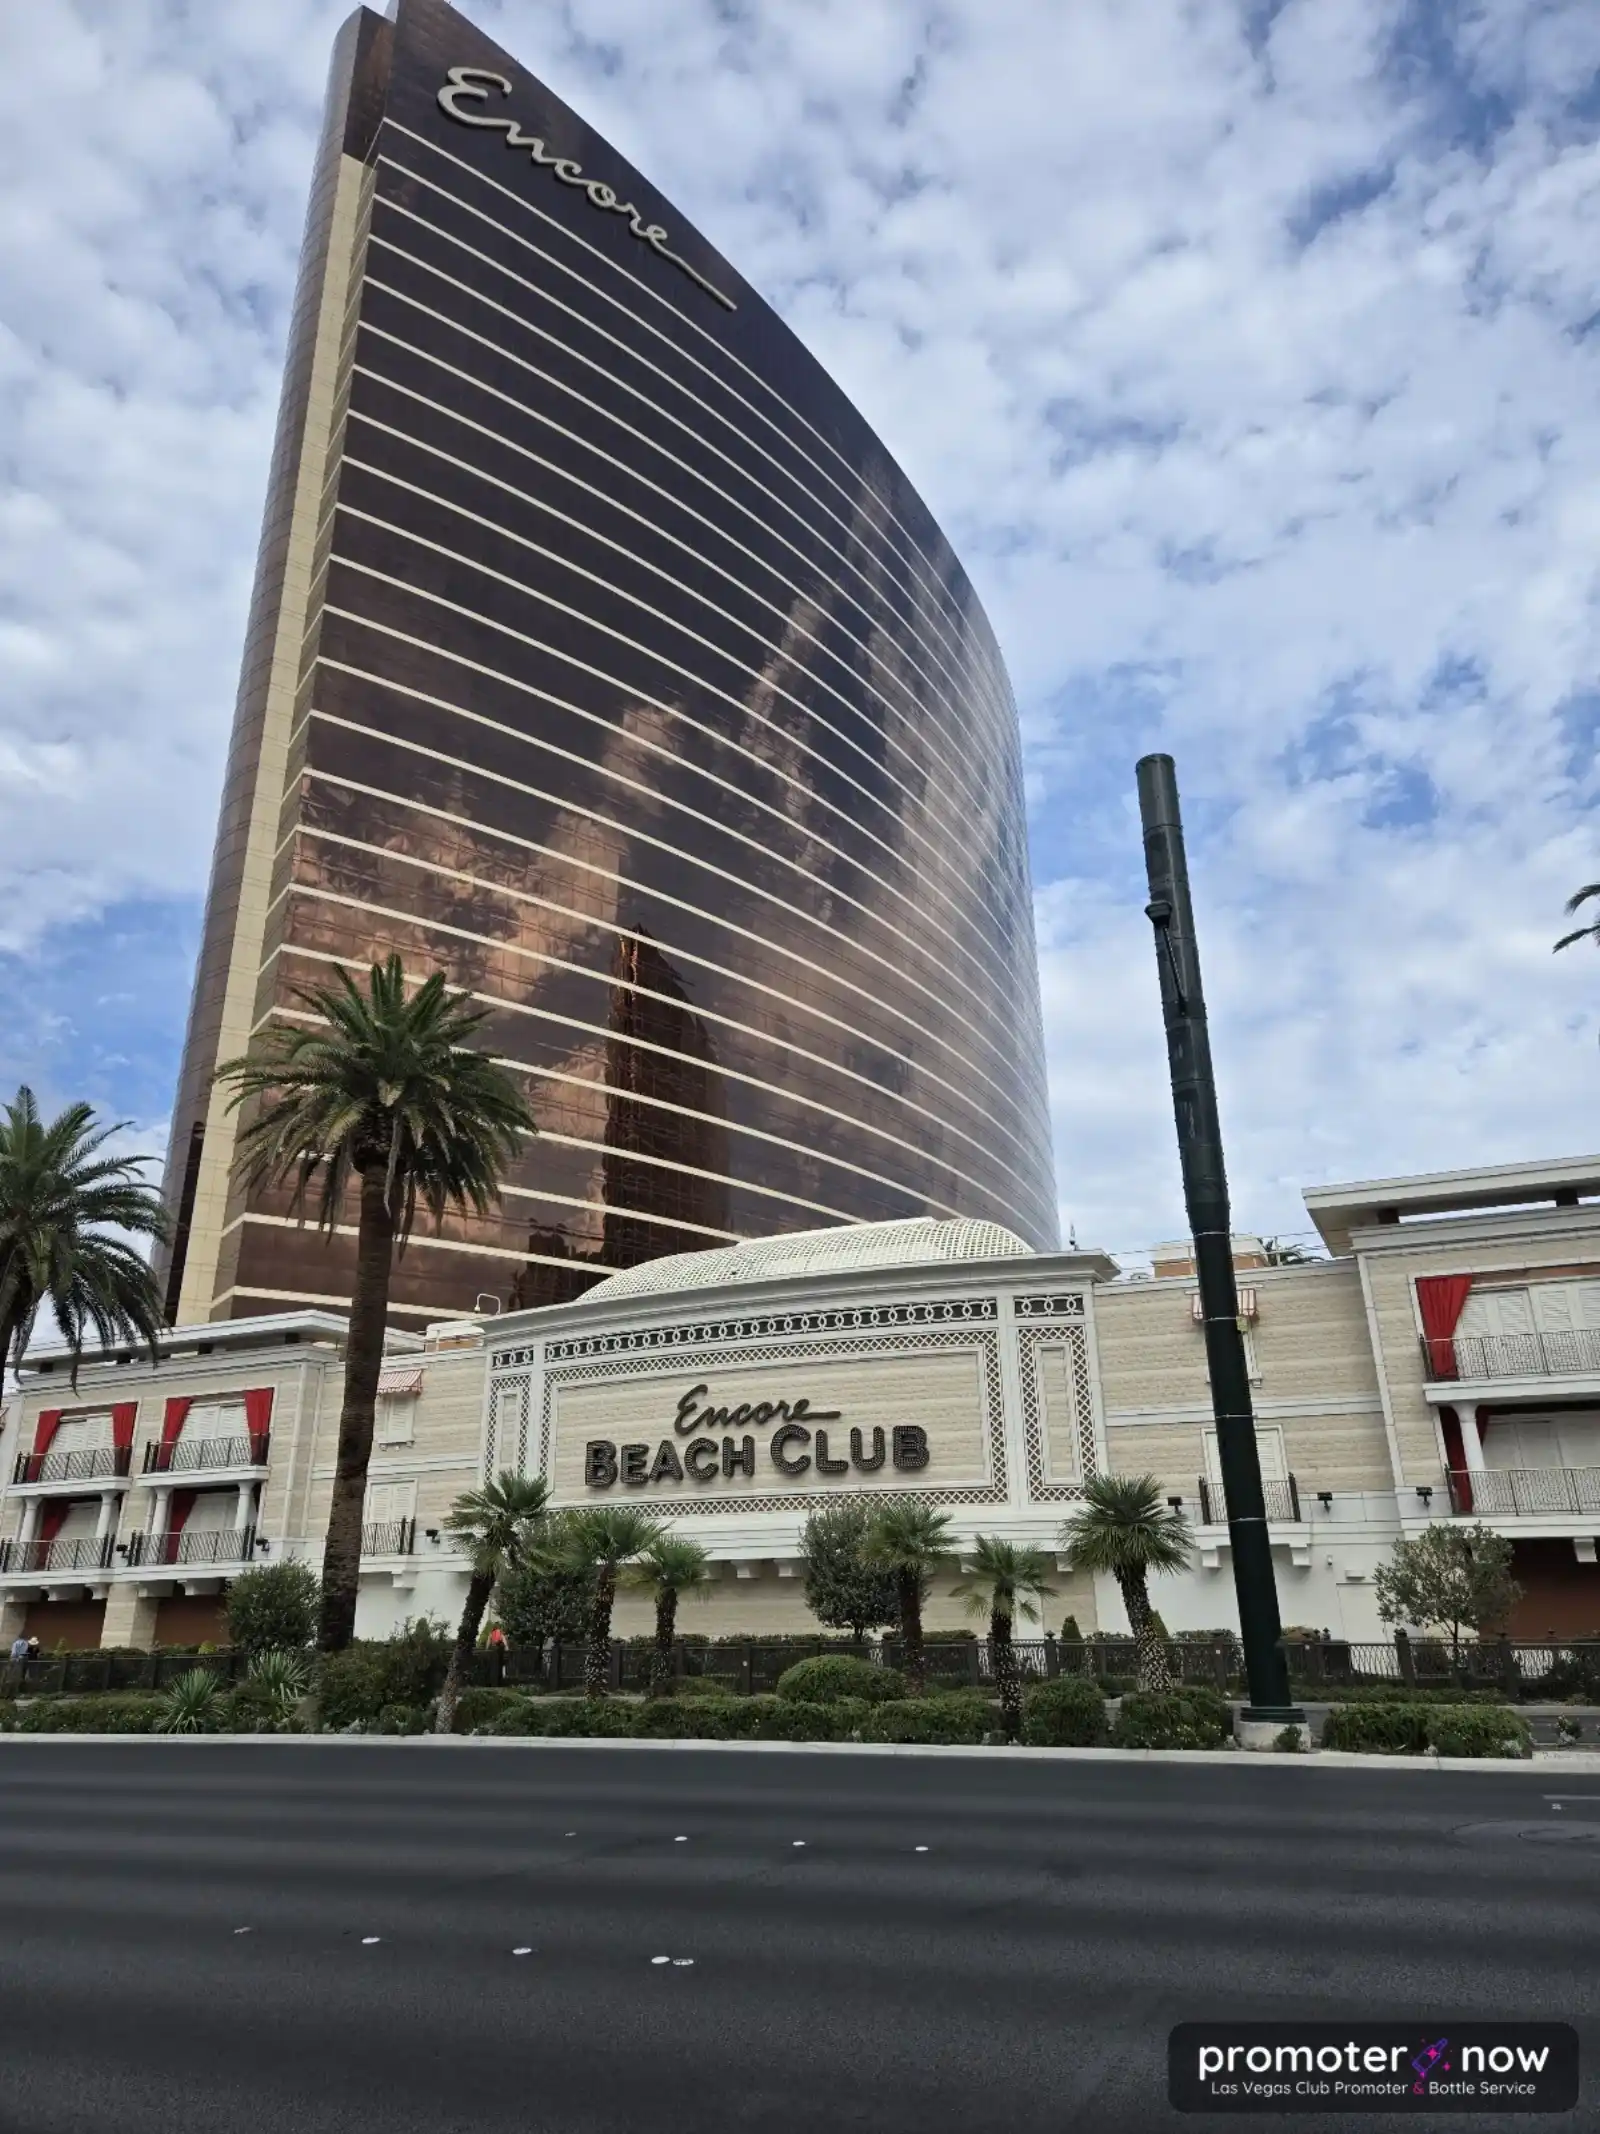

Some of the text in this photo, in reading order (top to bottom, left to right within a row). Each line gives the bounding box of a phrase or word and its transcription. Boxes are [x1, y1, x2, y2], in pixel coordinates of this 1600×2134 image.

[437, 66, 738, 312] Encore
[674, 1384, 842, 1437] Encore
[584, 1424, 931, 1488] BEACH CLUB
